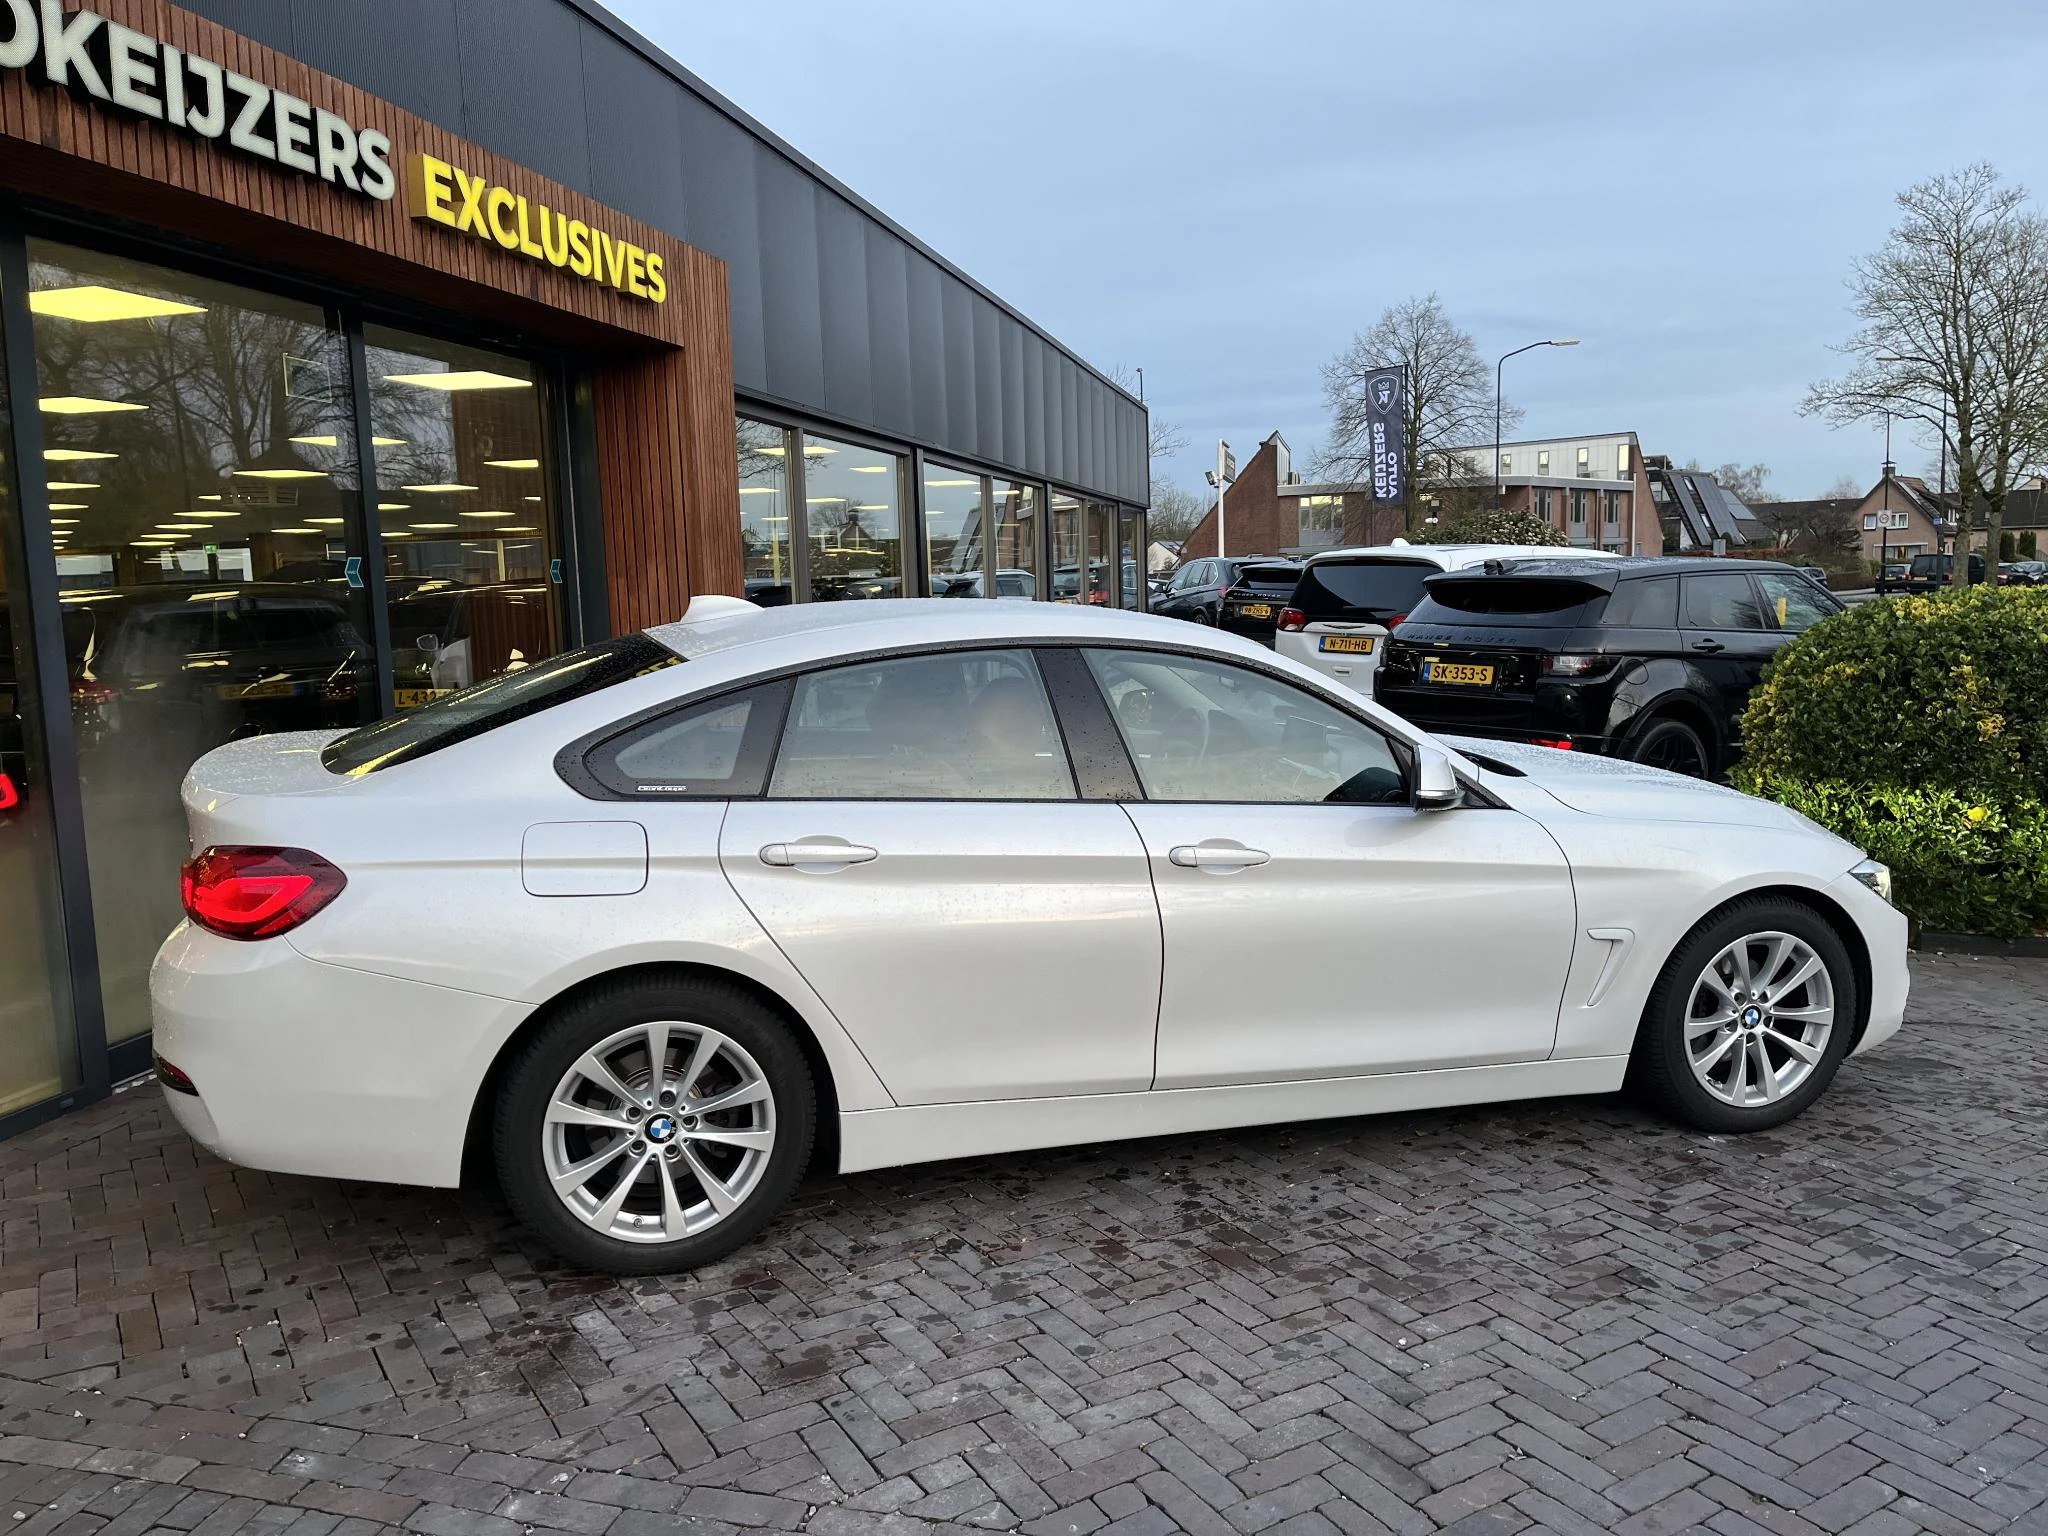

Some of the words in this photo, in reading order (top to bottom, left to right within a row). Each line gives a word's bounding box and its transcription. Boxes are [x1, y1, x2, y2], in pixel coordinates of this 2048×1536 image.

[421, 153, 668, 303] EXCLUSIVES
[1329, 639, 1367, 650] N-711-HB
[1433, 665, 1488, 682] SK-353-S
[398, 690, 448, 705] L-432
